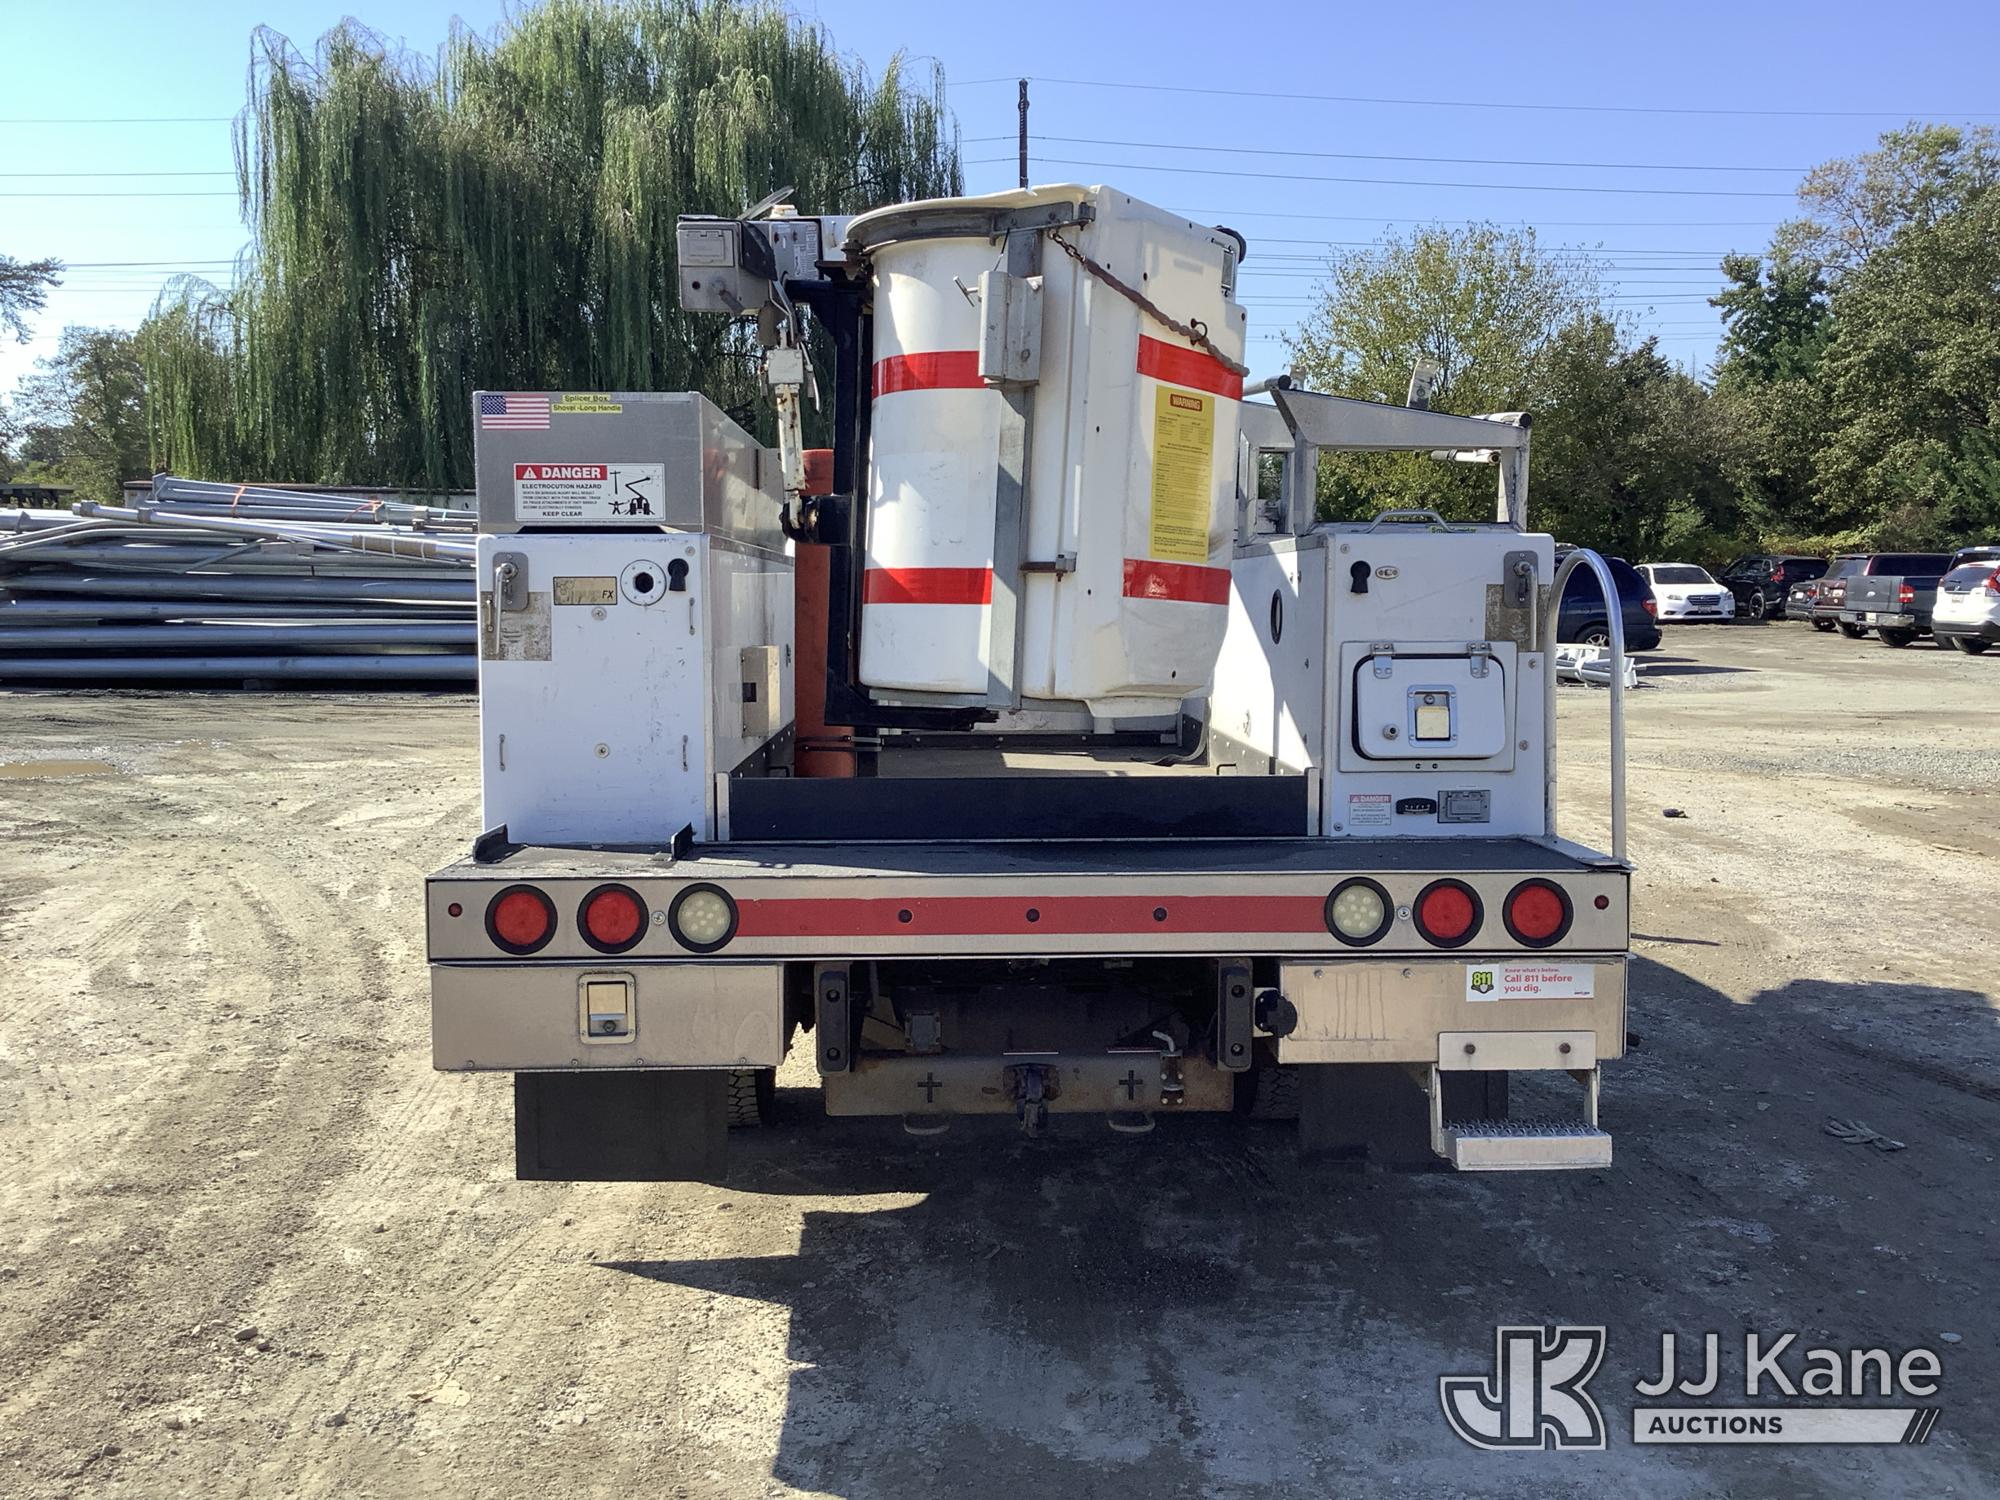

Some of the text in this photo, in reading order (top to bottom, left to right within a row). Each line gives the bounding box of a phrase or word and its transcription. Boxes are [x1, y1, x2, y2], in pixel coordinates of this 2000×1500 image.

[565, 394, 590, 402] Splicer
[1172, 395, 1201, 410] WARNING
[541, 467, 601, 479] DANGER
[602, 590, 614, 599] FX
[1472, 971, 1493, 986] 811
[1504, 975, 1521, 983] Call
[1542, 974, 1573, 982] before
[1504, 983, 1542, 994] you dig.
